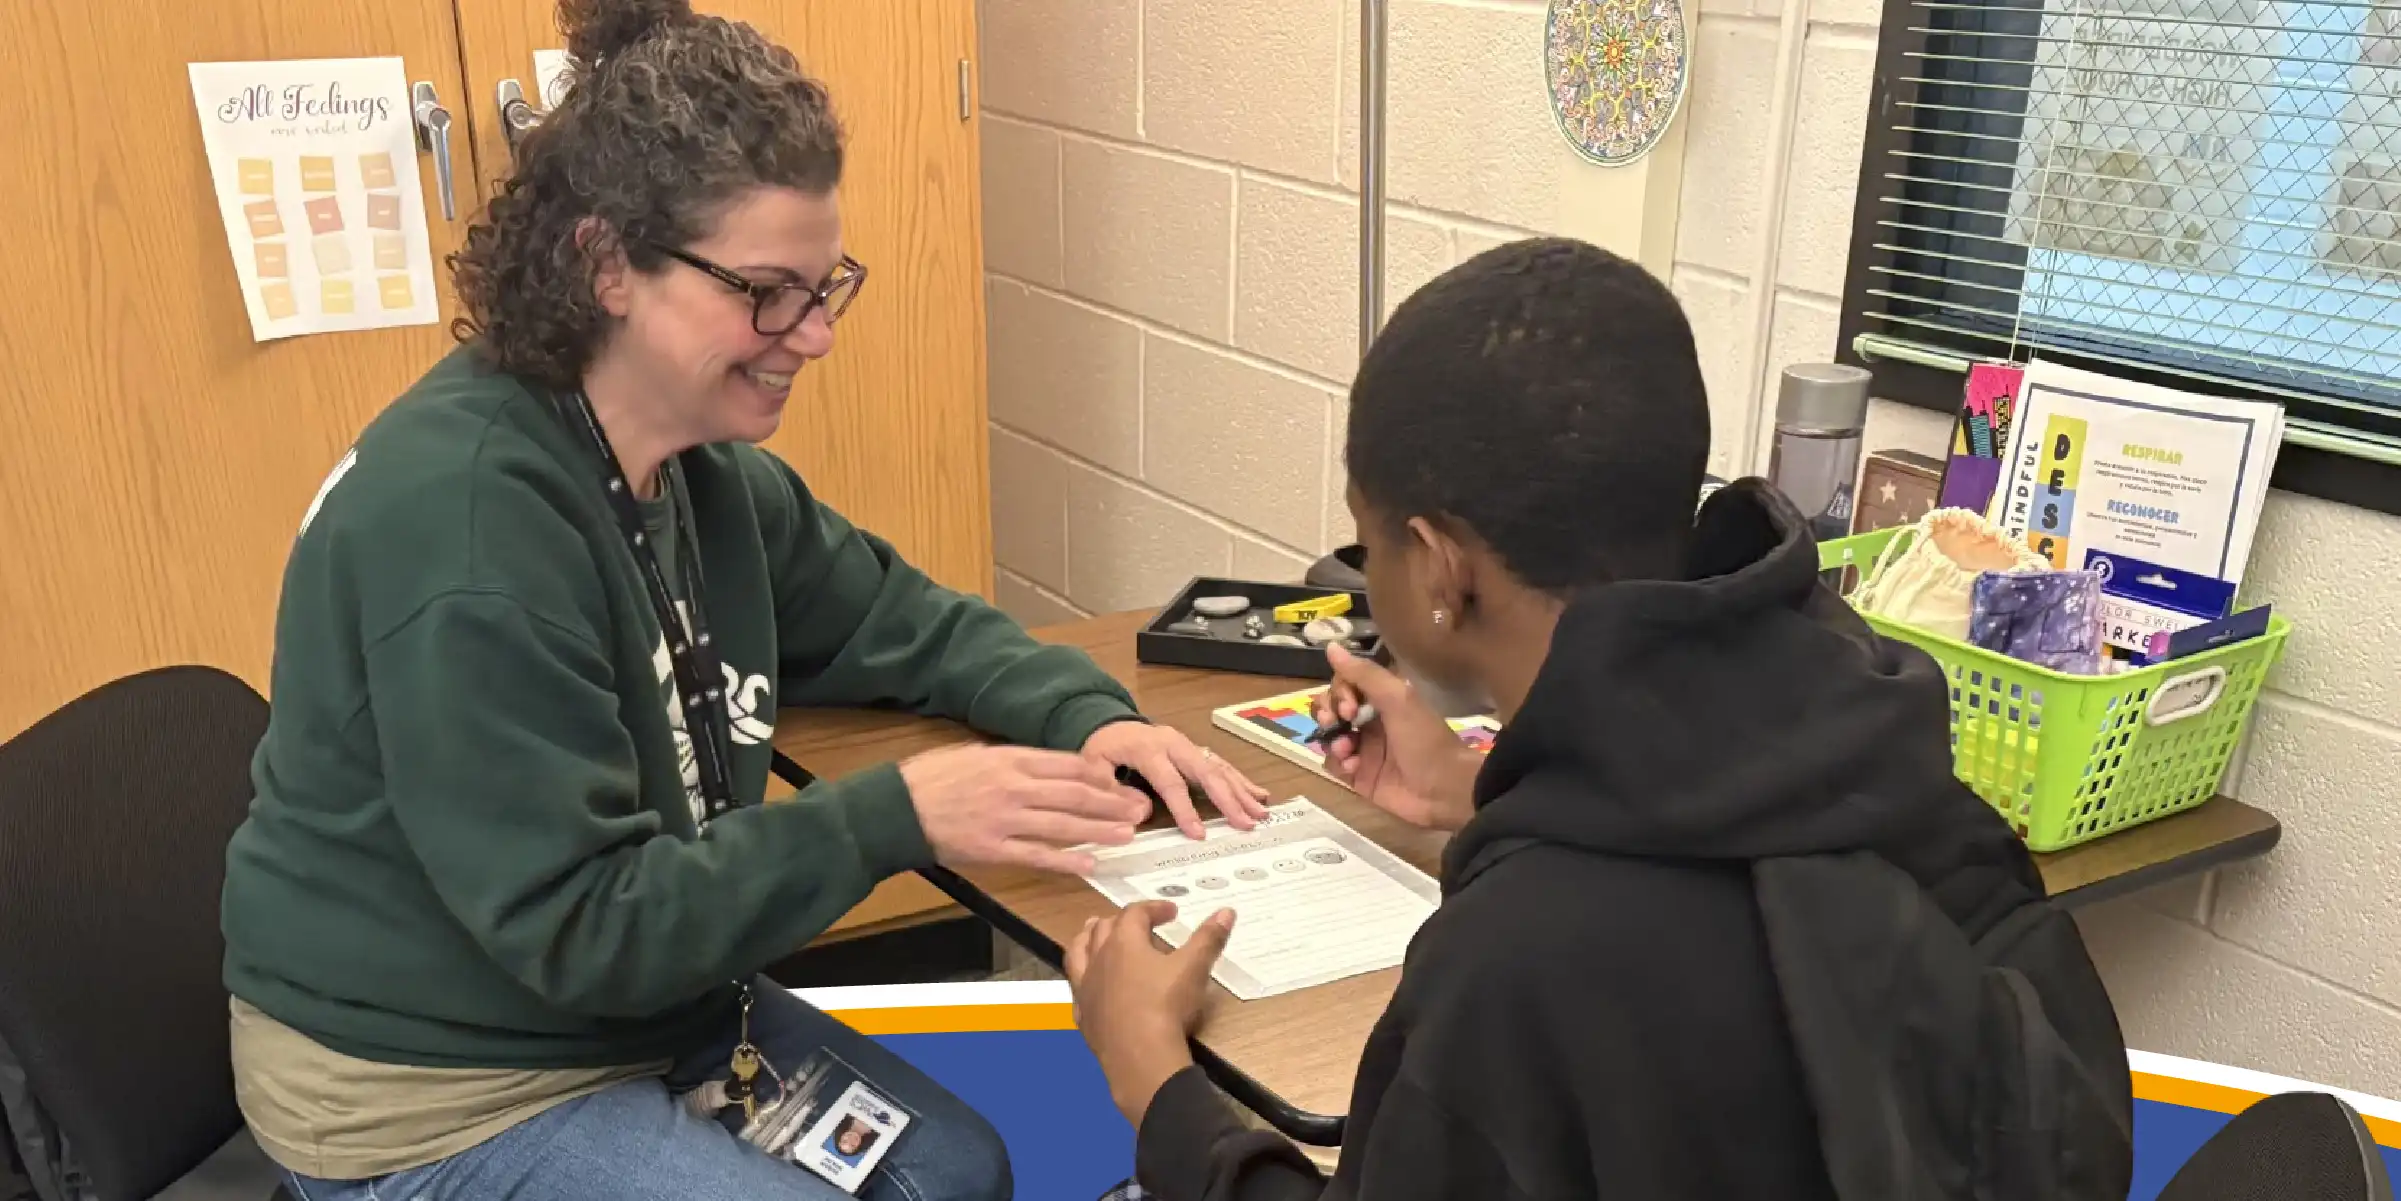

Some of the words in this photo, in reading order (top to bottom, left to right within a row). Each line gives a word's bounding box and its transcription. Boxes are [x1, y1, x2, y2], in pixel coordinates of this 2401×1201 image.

[217, 84, 274, 124] All
[281, 81, 390, 131] Feelings
[2122, 443, 2184, 466] RESPIRAR
[2106, 499, 2181, 524] RECONOCER
